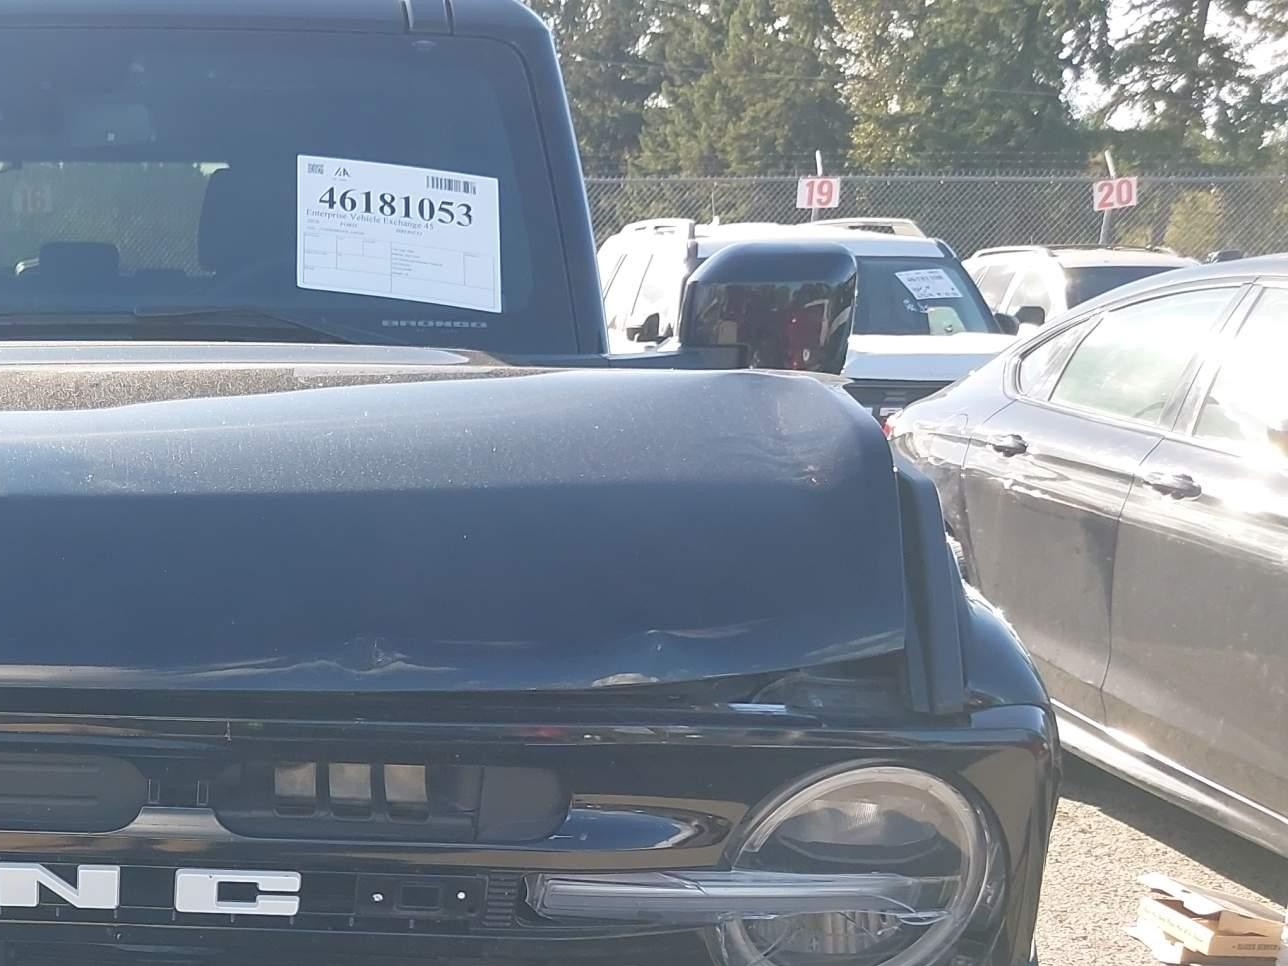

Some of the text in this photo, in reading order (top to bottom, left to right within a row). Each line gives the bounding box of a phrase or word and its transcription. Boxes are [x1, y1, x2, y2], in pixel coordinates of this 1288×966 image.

[318, 186, 474, 228] 46181053
[804, 179, 834, 207] 19
[1096, 179, 1133, 209] 20
[306, 208, 347, 220] Enterprise
[349, 213, 381, 224] Vehicle
[383, 217, 422, 230] Exchange
